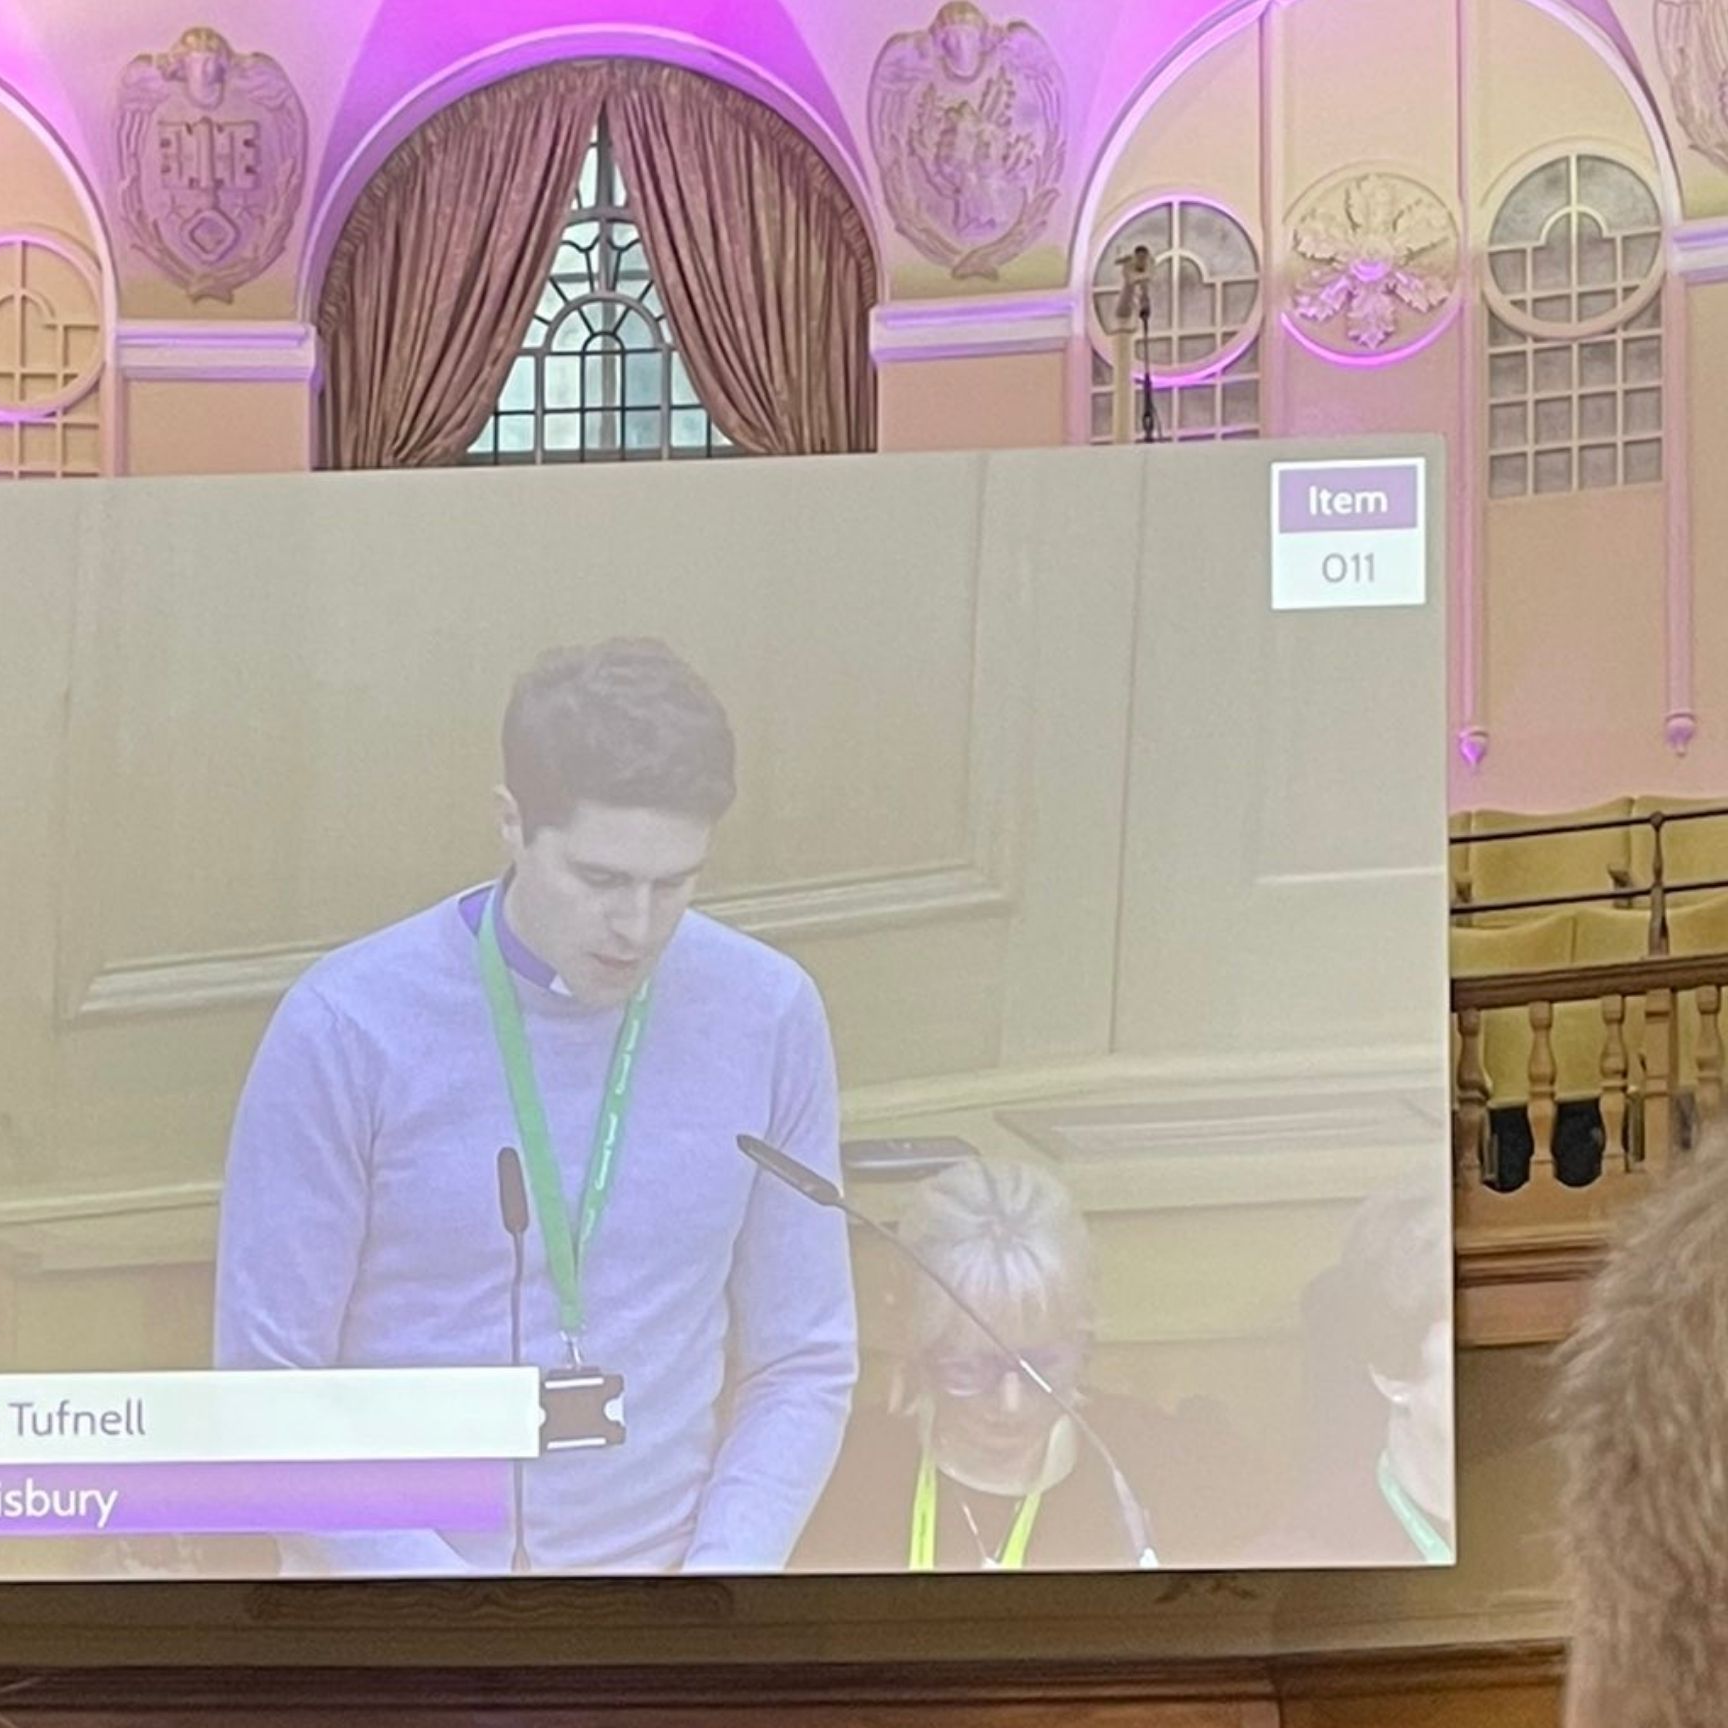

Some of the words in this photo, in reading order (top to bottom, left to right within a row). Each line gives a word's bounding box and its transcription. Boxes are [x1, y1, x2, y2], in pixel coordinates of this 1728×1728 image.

[1308, 485, 1388, 516] Item
[1321, 552, 1376, 584] 011
[7, 1398, 146, 1438] Tufnell
